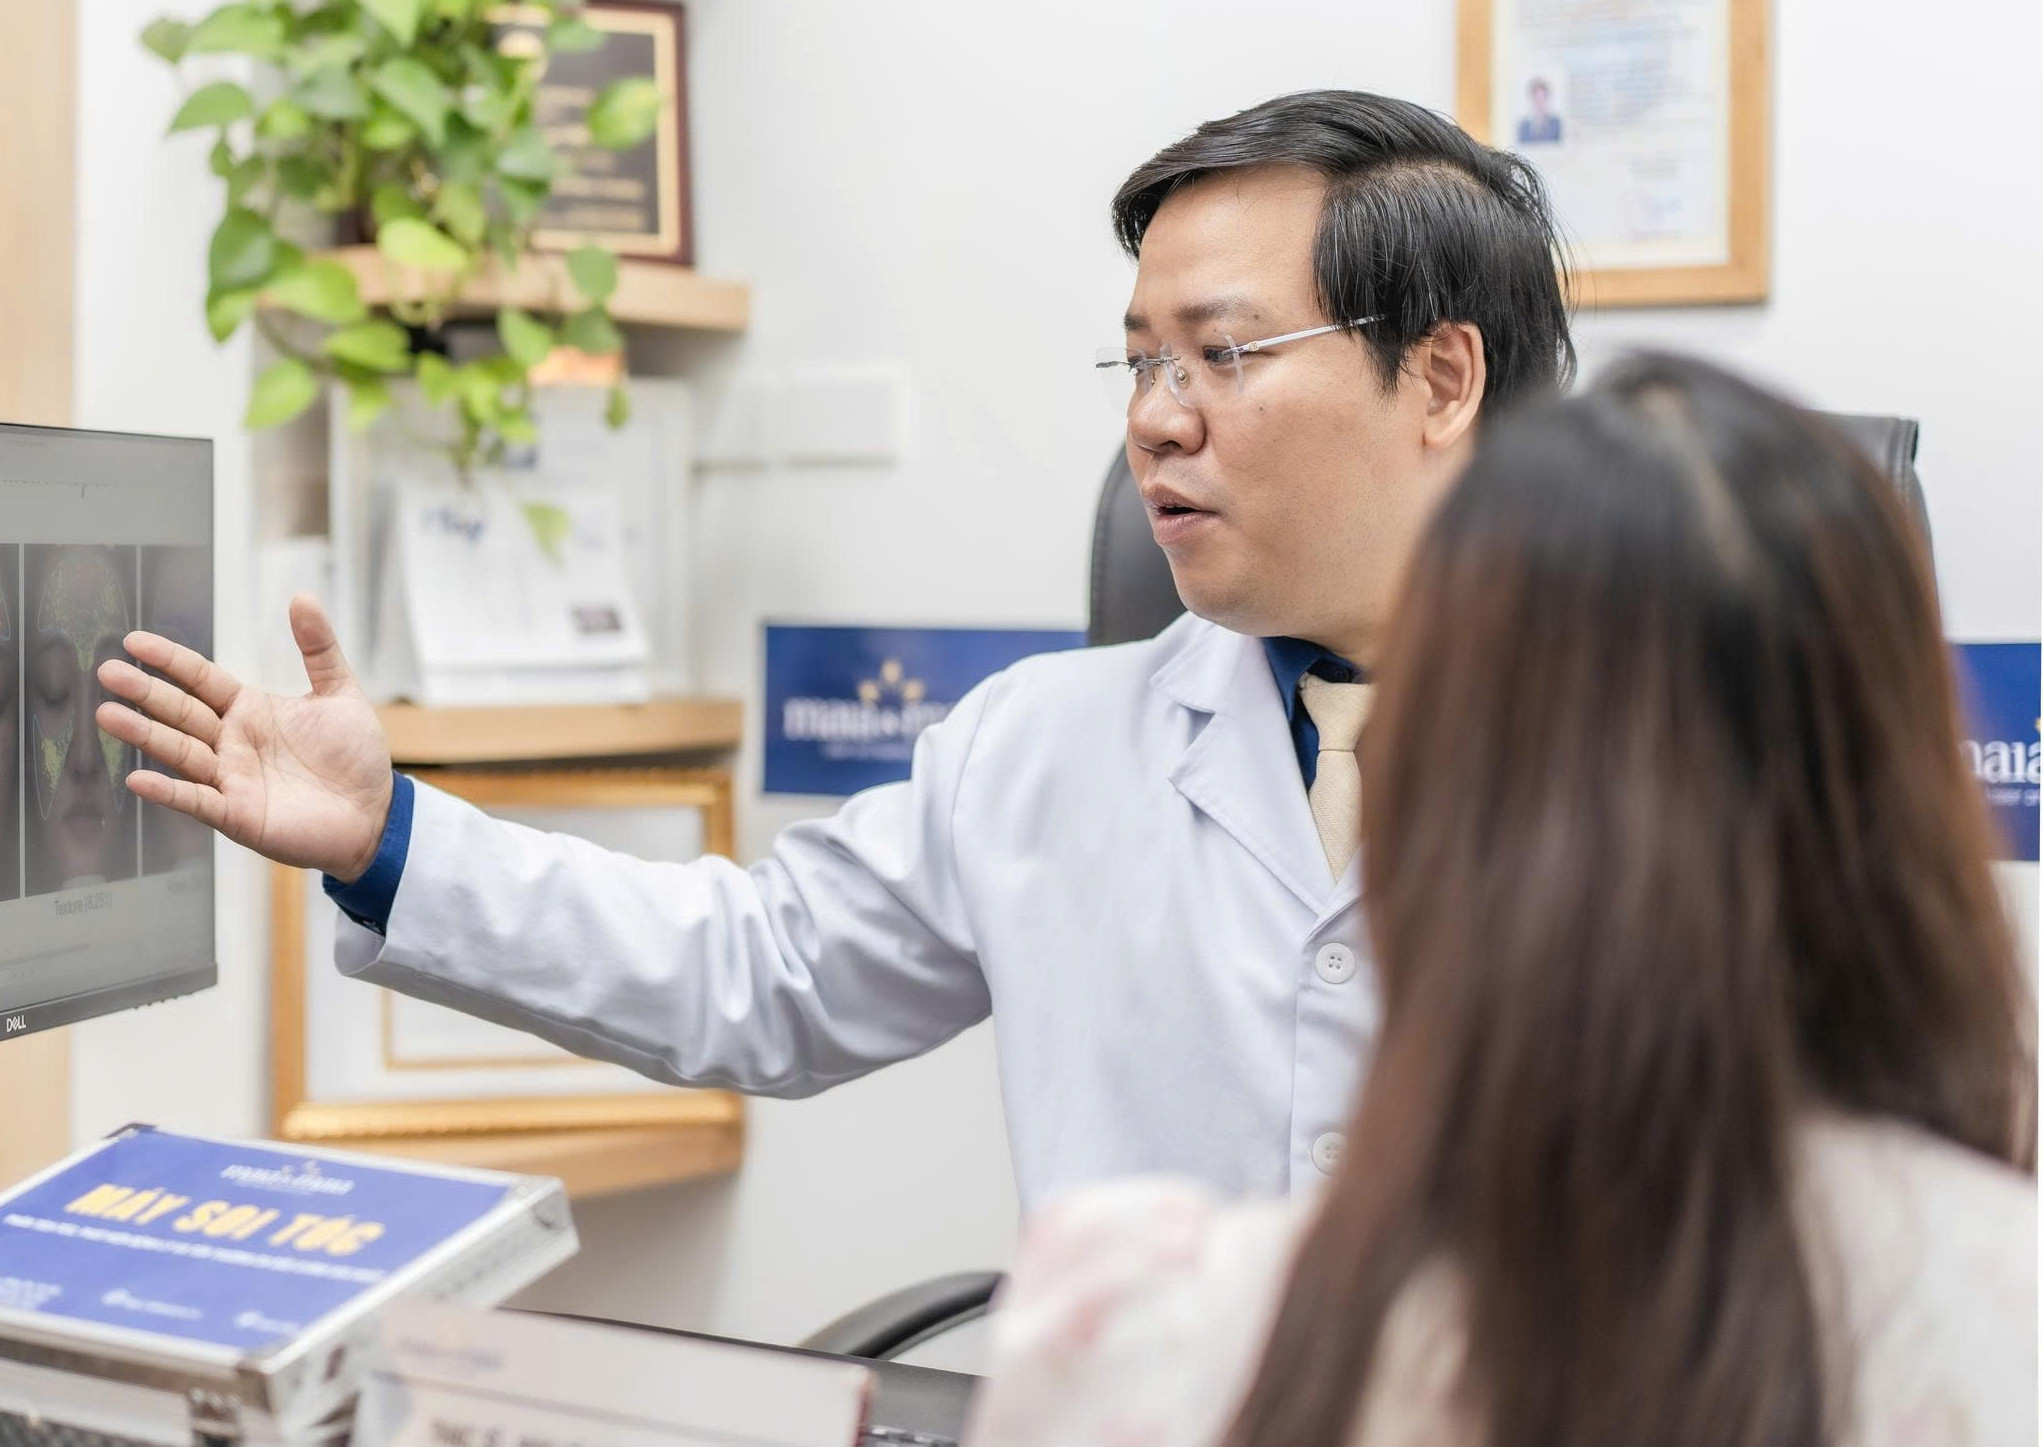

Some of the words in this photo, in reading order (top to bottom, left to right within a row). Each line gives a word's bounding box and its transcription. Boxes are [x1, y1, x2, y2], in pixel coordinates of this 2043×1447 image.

[54, 900, 83, 918] Texture
[6, 1014, 27, 1033] DELL
[64, 1183, 191, 1225] MÁY
[172, 1200, 281, 1241] SOI
[268, 1214, 385, 1256] TÓC
